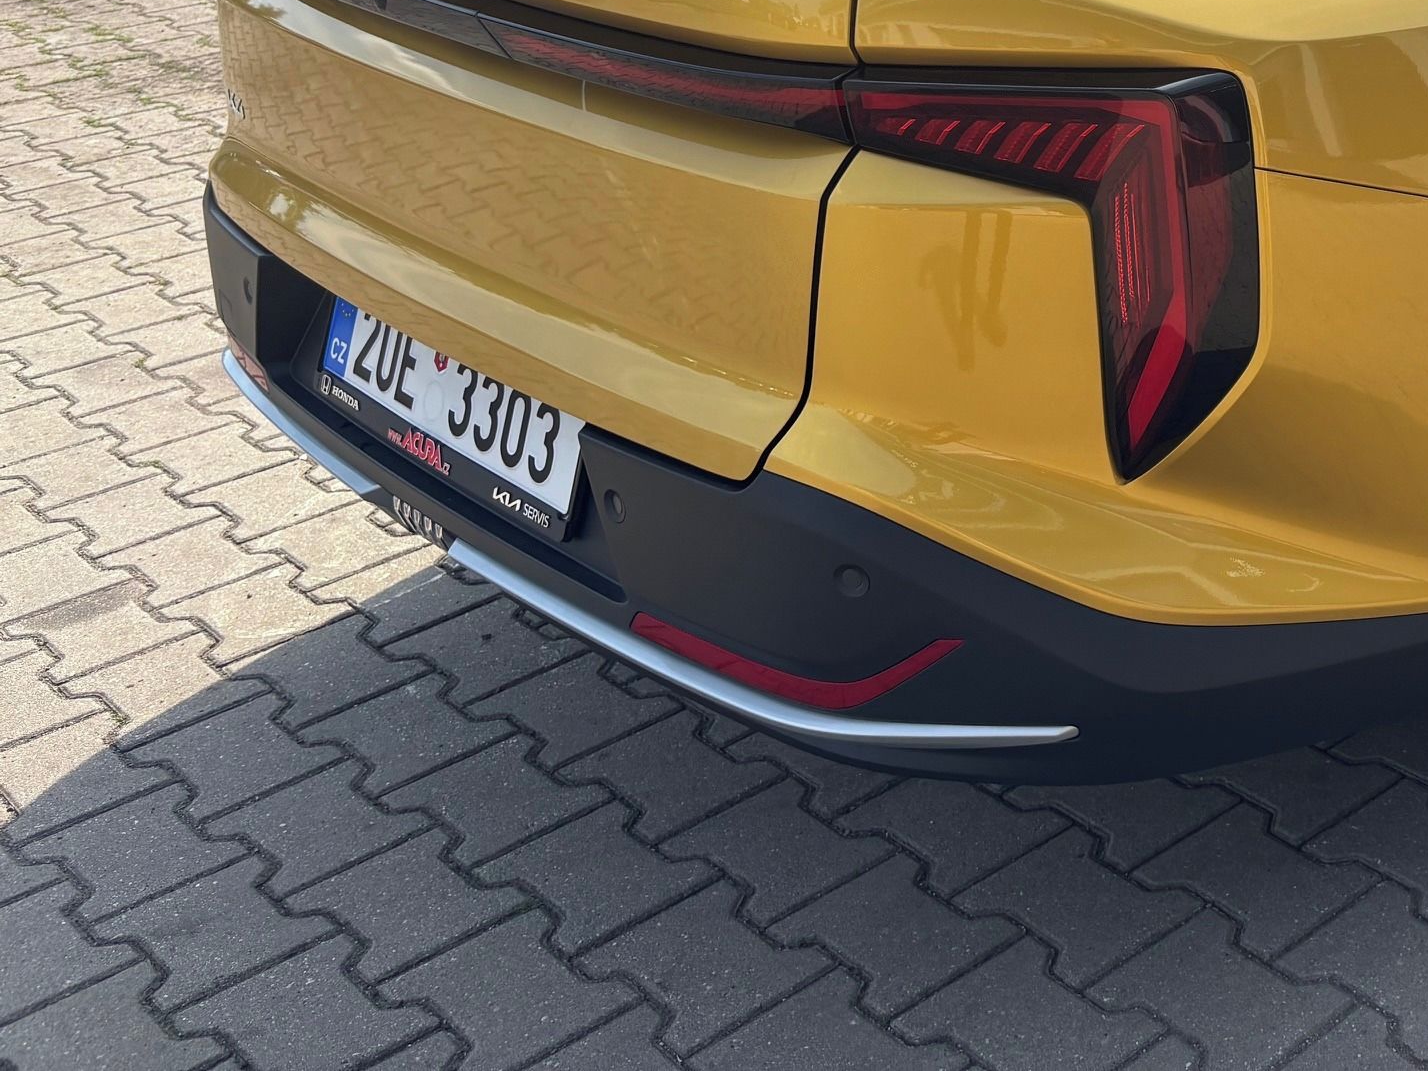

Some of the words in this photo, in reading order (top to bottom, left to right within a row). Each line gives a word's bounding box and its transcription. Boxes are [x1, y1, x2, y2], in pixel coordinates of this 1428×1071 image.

[330, 337, 348, 365] CZ
[331, 385, 360, 412] HONDA
[353, 313, 417, 410] 2UE
[448, 362, 561, 484] 3303
[492, 485, 521, 512] KIA
[522, 503, 550, 529] SERVIS
